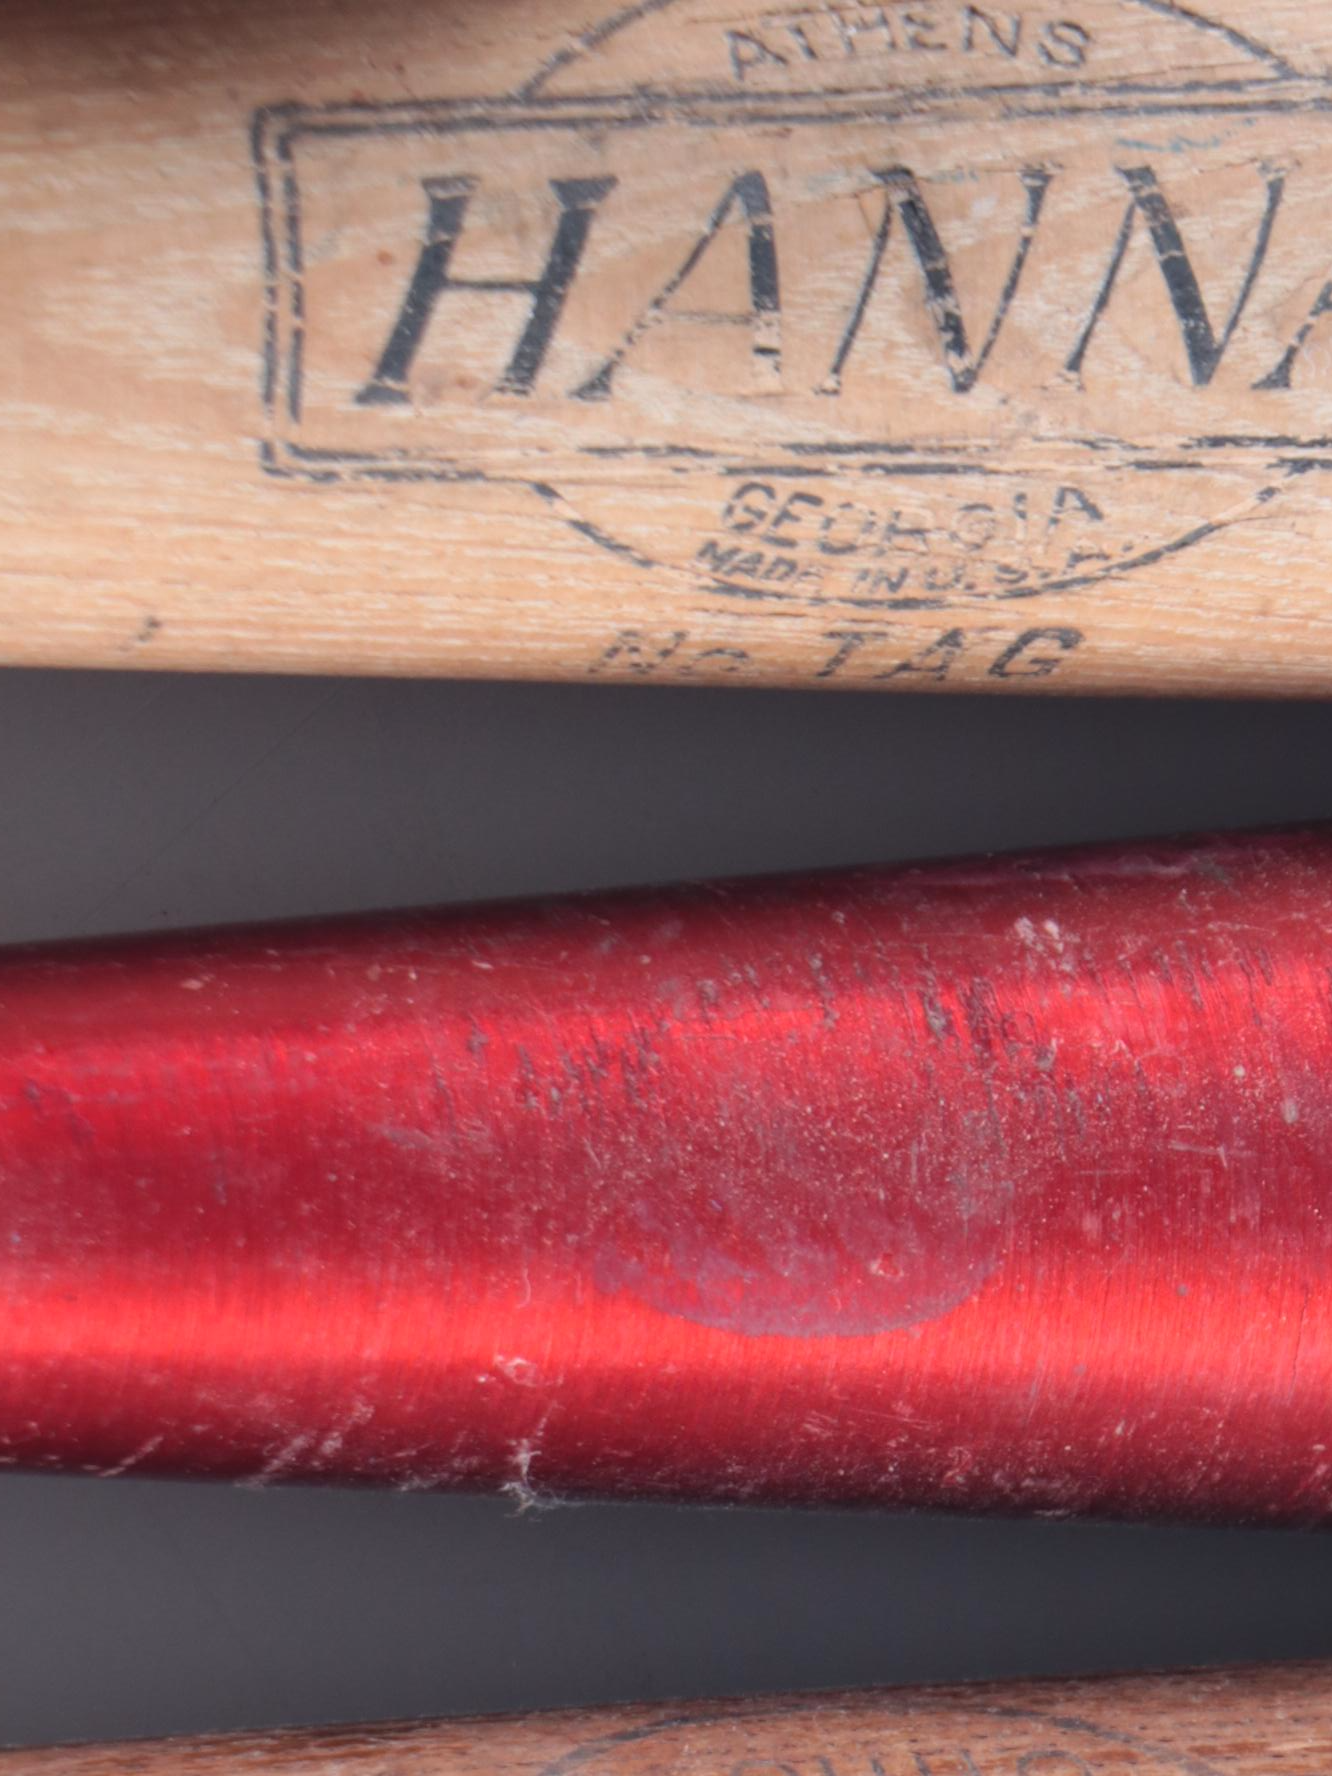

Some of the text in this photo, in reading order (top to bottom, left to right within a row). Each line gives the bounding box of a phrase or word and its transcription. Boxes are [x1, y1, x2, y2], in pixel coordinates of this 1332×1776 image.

[725, 4, 1092, 81] ATHENS
[722, 481, 1103, 559] GEORGIA
[851, 565, 909, 594] IN
[816, 626, 1085, 682] TAG
